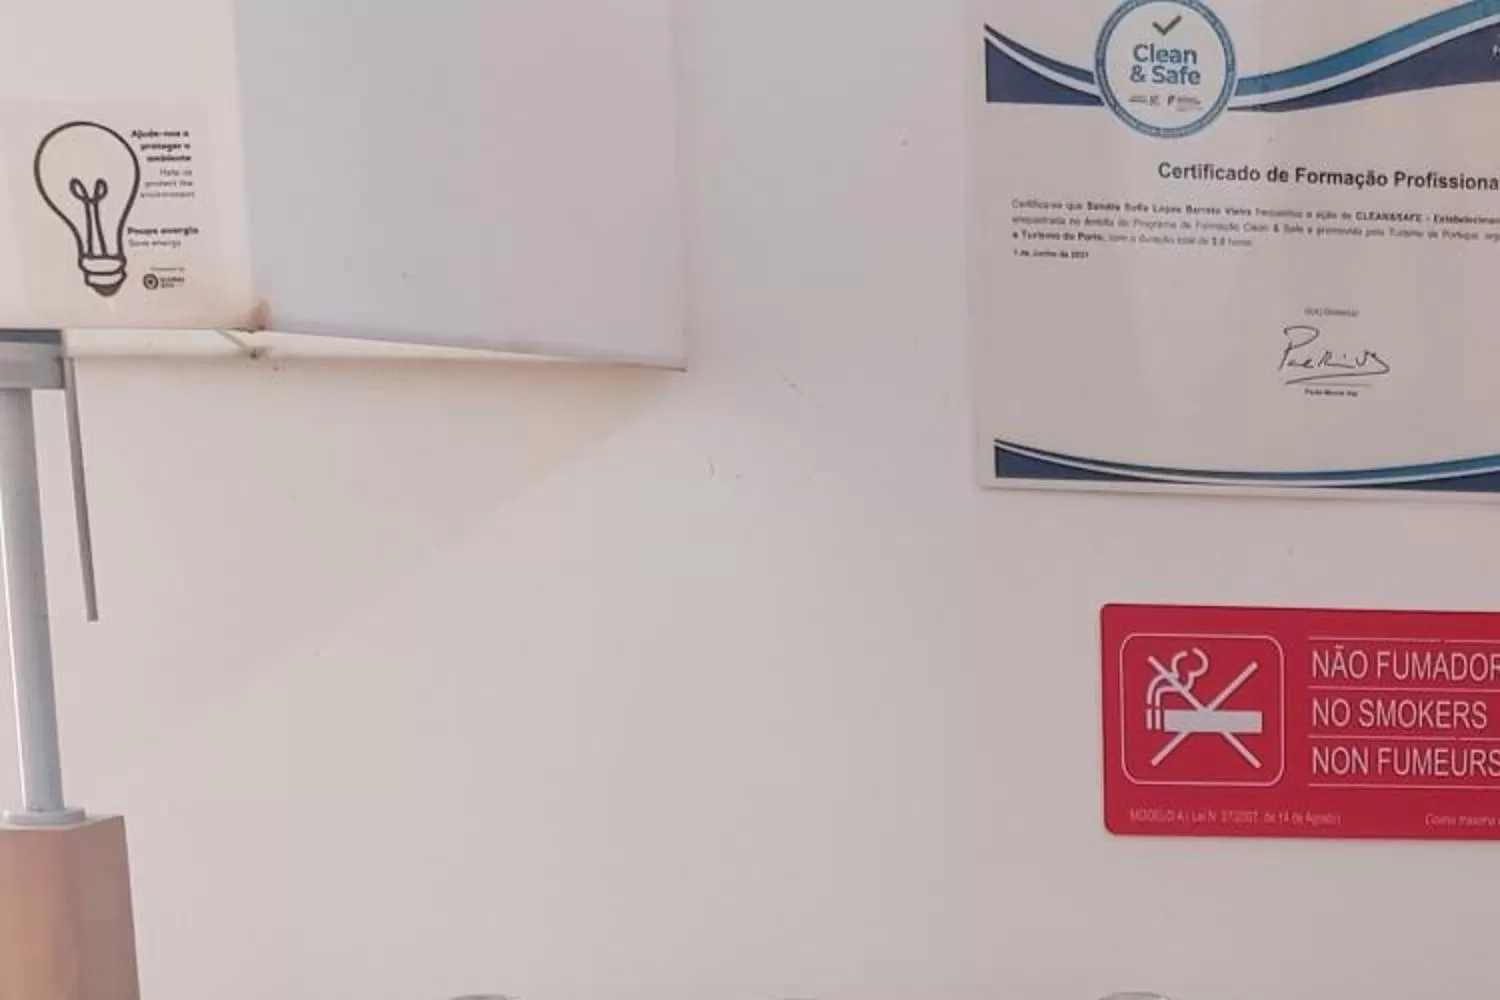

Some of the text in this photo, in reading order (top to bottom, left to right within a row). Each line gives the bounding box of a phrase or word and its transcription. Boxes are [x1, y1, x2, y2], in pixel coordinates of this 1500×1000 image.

[1133, 43, 1198, 63] Clean
[1129, 65, 1201, 85] & Safe
[1158, 161, 1261, 182] Certificado
[1266, 167, 1289, 183] de
[1295, 168, 1388, 189] Formação
[1355, 211, 1423, 223] CLEAN&SAFE
[1312, 645, 1369, 681] NÃO
[1311, 697, 1489, 730] NO SMOKERS
[1312, 746, 1369, 775] NON
